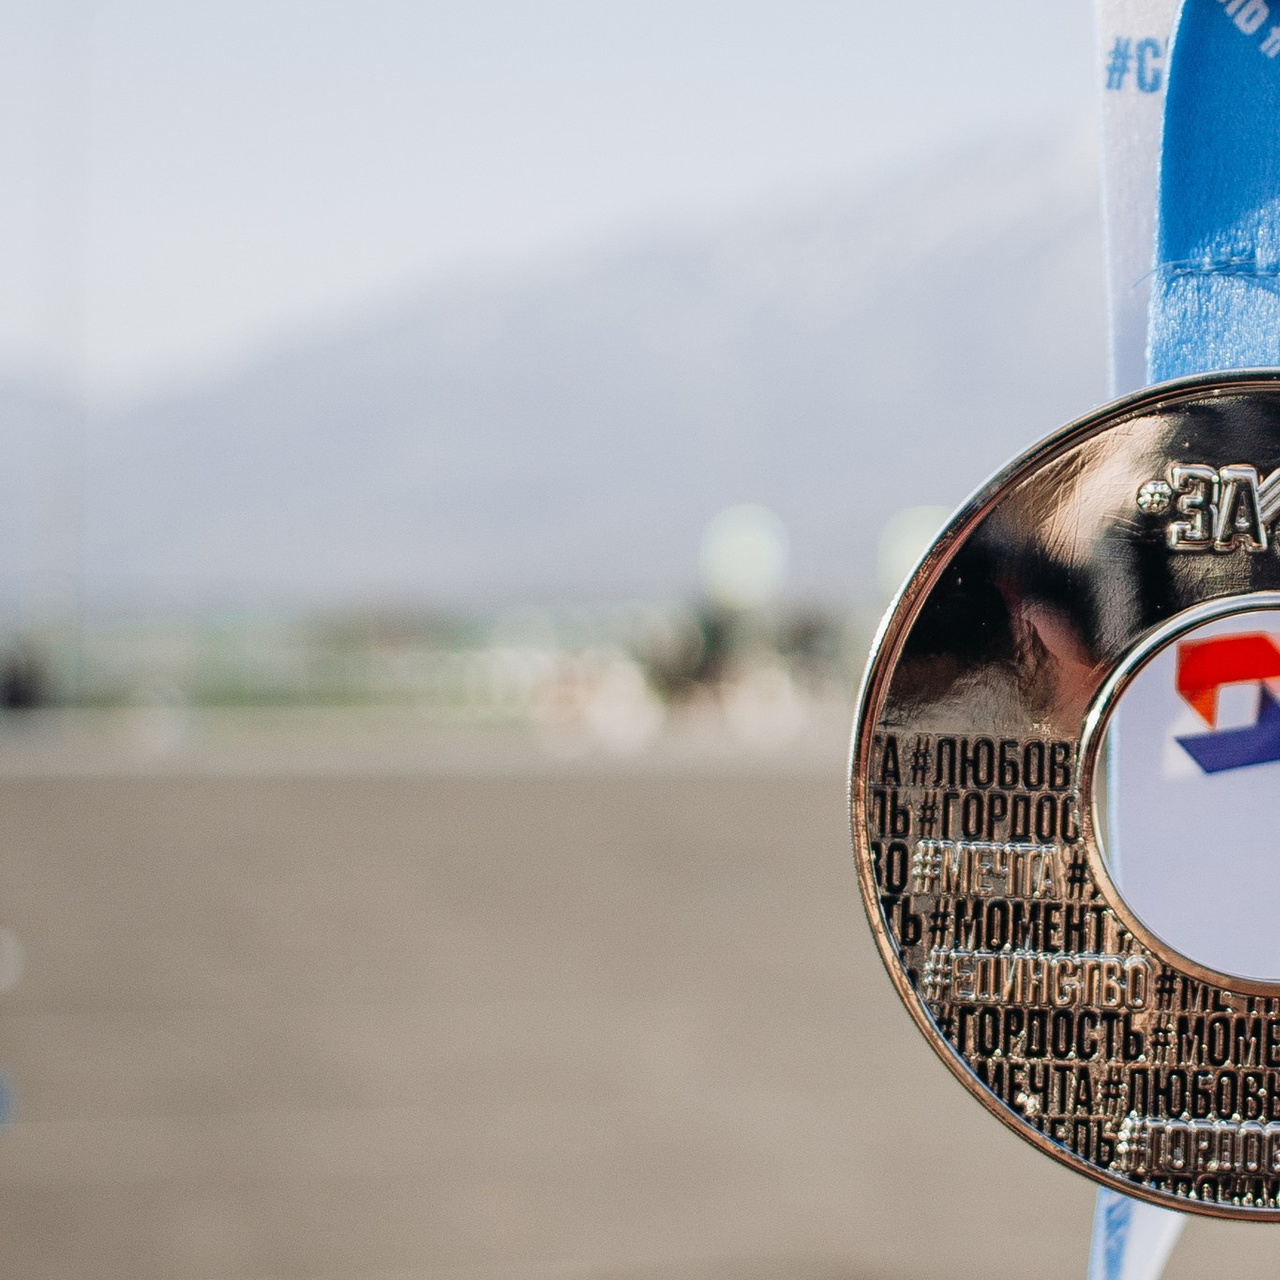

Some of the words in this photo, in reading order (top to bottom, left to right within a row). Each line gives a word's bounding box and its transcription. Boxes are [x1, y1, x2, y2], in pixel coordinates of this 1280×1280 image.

[1105, 34, 1169, 93] #С
[910, 734, 1078, 792] #ЛЮБОВ
[912, 839, 1060, 900] #МЕЧТА
[929, 896, 1112, 955] #МОМЕНТ
[921, 948, 1152, 1011] #ЕДИНСТВО
